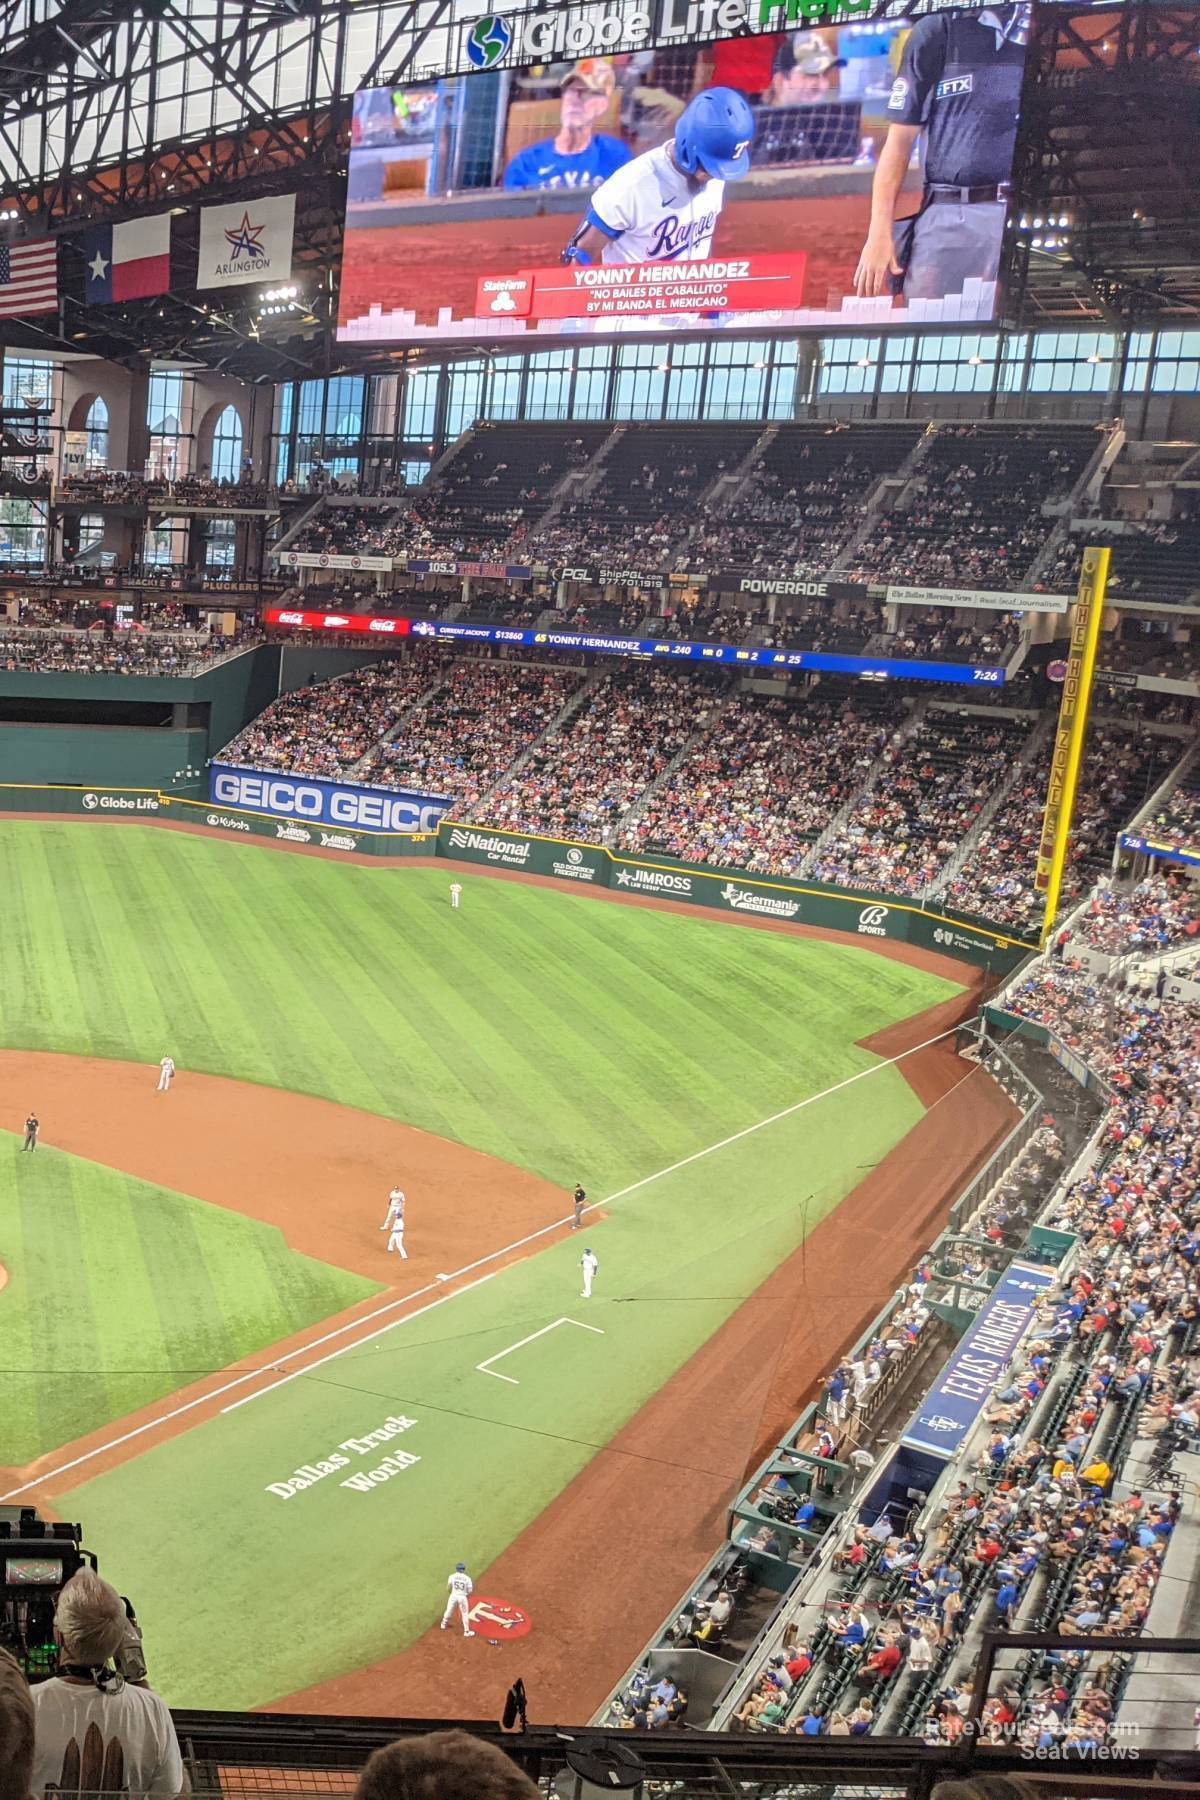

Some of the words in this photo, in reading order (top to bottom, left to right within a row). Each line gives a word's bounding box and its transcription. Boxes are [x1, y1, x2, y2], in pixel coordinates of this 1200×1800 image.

[522, 11, 650, 57] Globe
[660, 0, 746, 38] Life
[941, 78, 971, 96] FTX
[215, 258, 270, 276] ARLINGTON
[574, 267, 636, 286] YONNY
[638, 261, 750, 281] HERNANDEZ
[612, 287, 647, 298] BAILES
[648, 286, 663, 297] DE
[586, 302, 601, 312] BY
[602, 301, 615, 311] MI
[616, 299, 653, 311] BANDA
[655, 298, 668, 309] EL
[670, 296, 728, 308] MEXICANO
[428, 562, 457, 574] 105.3
[561, 568, 593, 582] PGL
[201, 581, 260, 591] PLUCKERS
[740, 579, 829, 597] POWERADE
[904, 591, 925, 599] Dallas
[925, 592, 954, 602] Morning
[954, 593, 972, 602] News
[1073, 587, 1092, 646] THE
[439, 627, 466, 636] CURRENT
[467, 628, 491, 637] JACKPOT
[495, 630, 524, 641] $13860
[535, 634, 547, 644] 65
[548, 634, 582, 646] YONNY
[582, 636, 641, 651] HERNANDEZ
[671, 645, 692, 655] .240
[715, 648, 724, 658] 0
[750, 652, 758, 661] 2
[788, 655, 802, 664] 25
[973, 669, 998, 681] 7:26
[1063, 659, 1081, 716] HOT
[1048, 730, 1070, 806] ZONE
[99, 795, 134, 809] Globe
[135, 796, 160, 810] Life
[214, 773, 324, 817] GEICO
[329, 790, 444, 835] GEICO
[220, 815, 251, 832] Kubota
[466, 832, 531, 858] National
[1123, 837, 1142, 848] 7:26
[487, 851, 501, 862] Car
[501, 854, 527, 866] Rental
[554, 868, 579, 878] FREIGHT
[579, 872, 593, 880] LINE
[630, 881, 643, 889] LAW
[743, 891, 800, 912] Germania
[857, 924, 887, 937] SPORTS
[969, 1299, 1032, 1356] RANGERS
[940, 1353, 999, 1402] TEXAS
[264, 1452, 351, 1500] Dallas
[337, 1413, 419, 1456] Truck
[339, 1449, 422, 1493] World
[453, 1580, 466, 1592] 53
